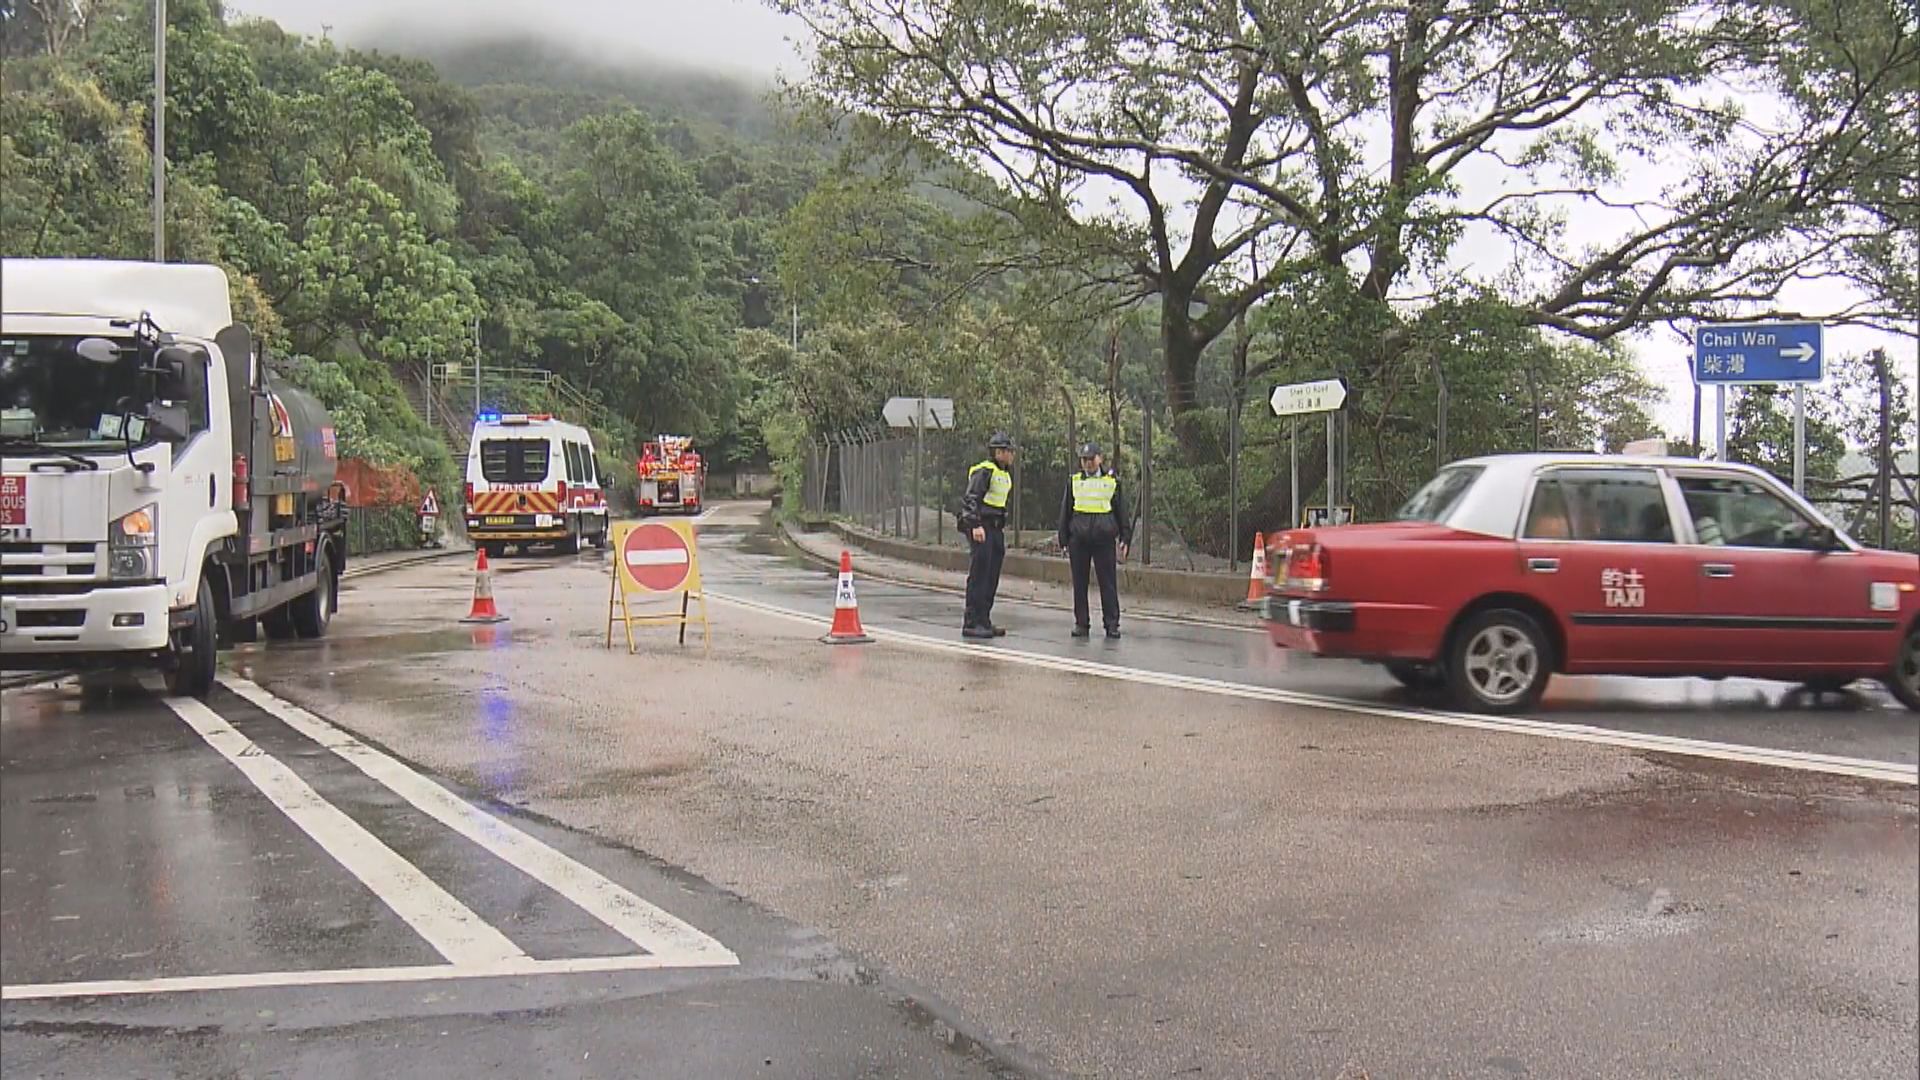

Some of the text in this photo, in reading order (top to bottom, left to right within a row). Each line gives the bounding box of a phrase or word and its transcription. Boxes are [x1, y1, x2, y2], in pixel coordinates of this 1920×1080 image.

[1702, 331, 1776, 347] Chai Wan
[1703, 353, 1745, 375] 柴灣
[1601, 567, 1644, 587] 的士
[1601, 587, 1645, 607] TAXI
